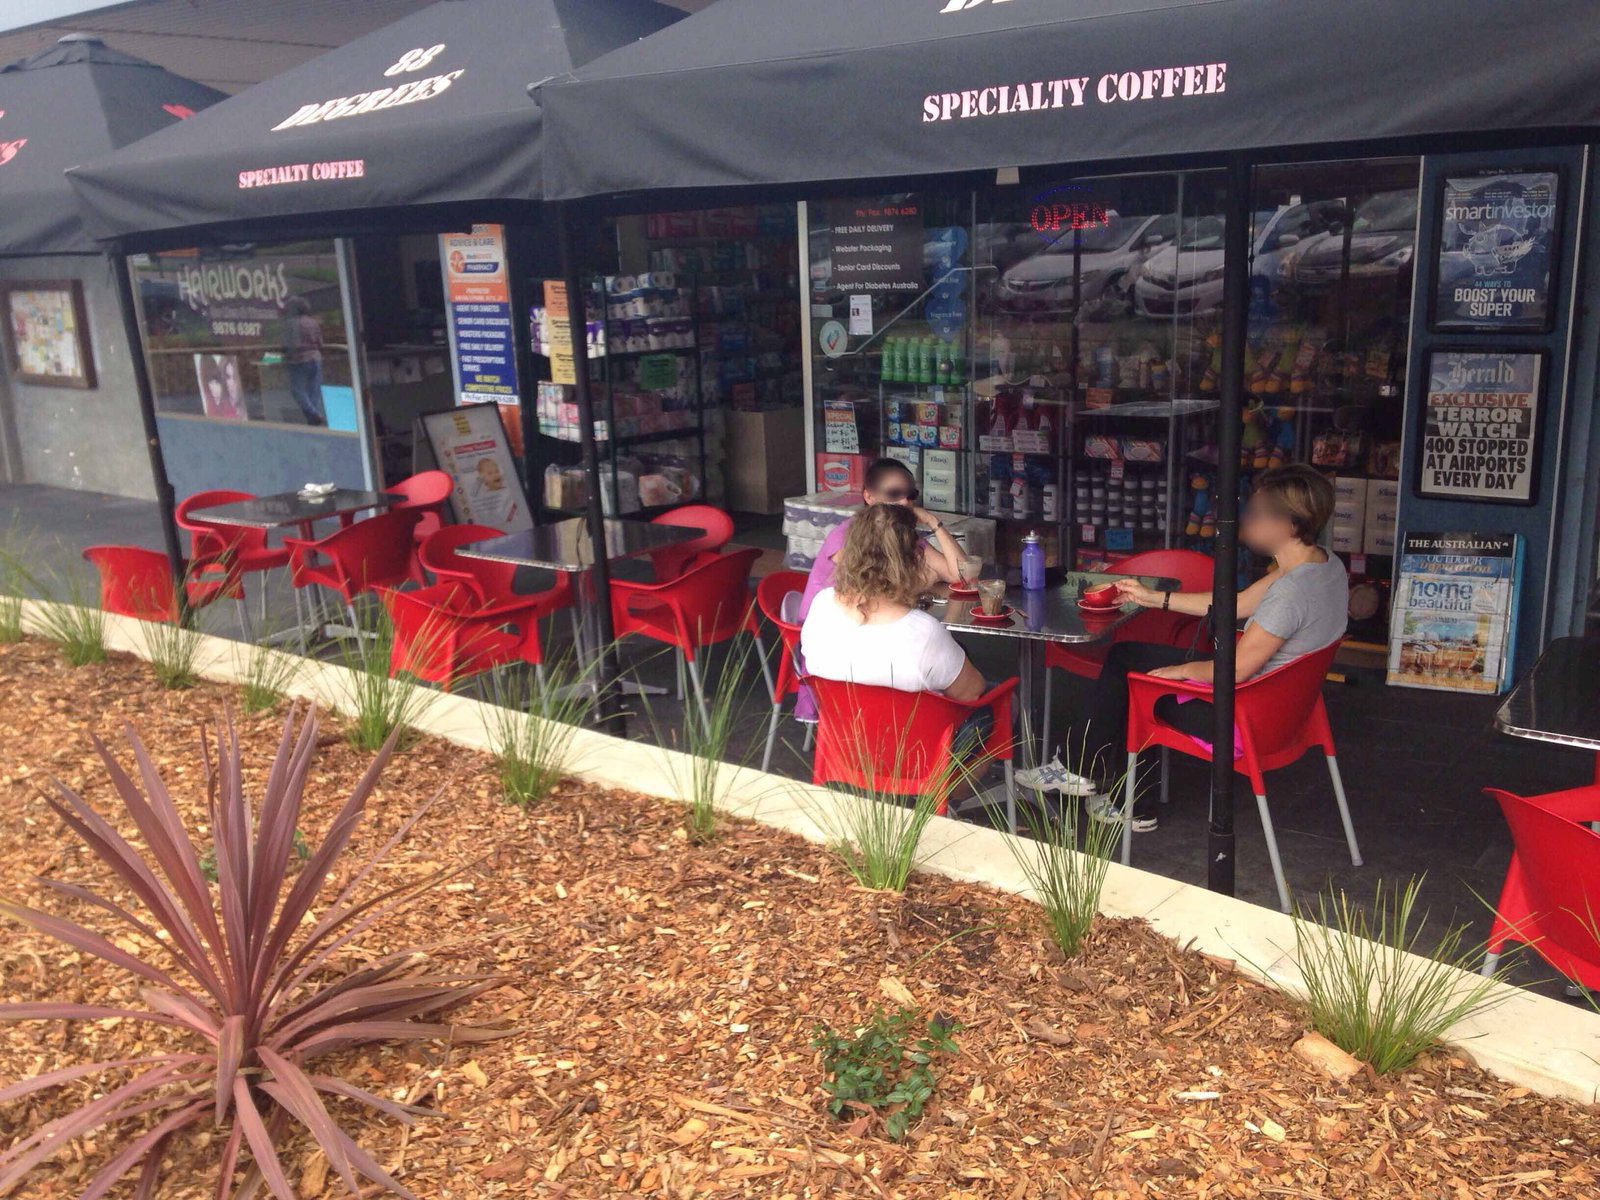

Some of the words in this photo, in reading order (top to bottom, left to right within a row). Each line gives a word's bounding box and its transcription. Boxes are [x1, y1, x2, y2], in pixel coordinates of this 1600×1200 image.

[384, 43, 446, 77] 88
[270, 68, 465, 131] DEGREES
[922, 77, 1090, 123] SPECIALTY
[1097, 63, 1228, 104] COFFEE
[239, 164, 309, 188] SPECIALTY
[312, 160, 364, 180] COFFEE
[1031, 200, 1110, 232] OPEN
[1446, 202, 1556, 220] smartinvestor
[835, 226, 848, 234] FREE
[848, 225, 865, 234] DAILY
[867, 224, 894, 233] DELIVERY
[835, 245, 859, 253] Webster
[860, 244, 892, 253] Packaging
[837, 264, 856, 272] Senior
[856, 263, 872, 271] Card
[872, 263, 901, 271] Discounts
[836, 282, 855, 291] Agent
[1454, 288, 1496, 302] BOOST
[1501, 288, 1536, 303] YOUR
[1470, 303, 1512, 317] SUPER
[1448, 359, 1516, 384] Herald
[1430, 393, 1528, 407] EXCLUSIVE
[1434, 407, 1522, 423] TERROR
[1437, 422, 1517, 438] WATCH
[1425, 438, 1455, 453] 400
[1458, 439, 1528, 456] STOPPED
[1426, 454, 1446, 470] AT
[1449, 455, 1526, 473] AIRPORTS
[1433, 471, 1481, 488] EVERY
[1485, 473, 1517, 490] DAY
[1408, 539, 1430, 548] THE
[1431, 540, 1502, 550] AUSTRALIAN
